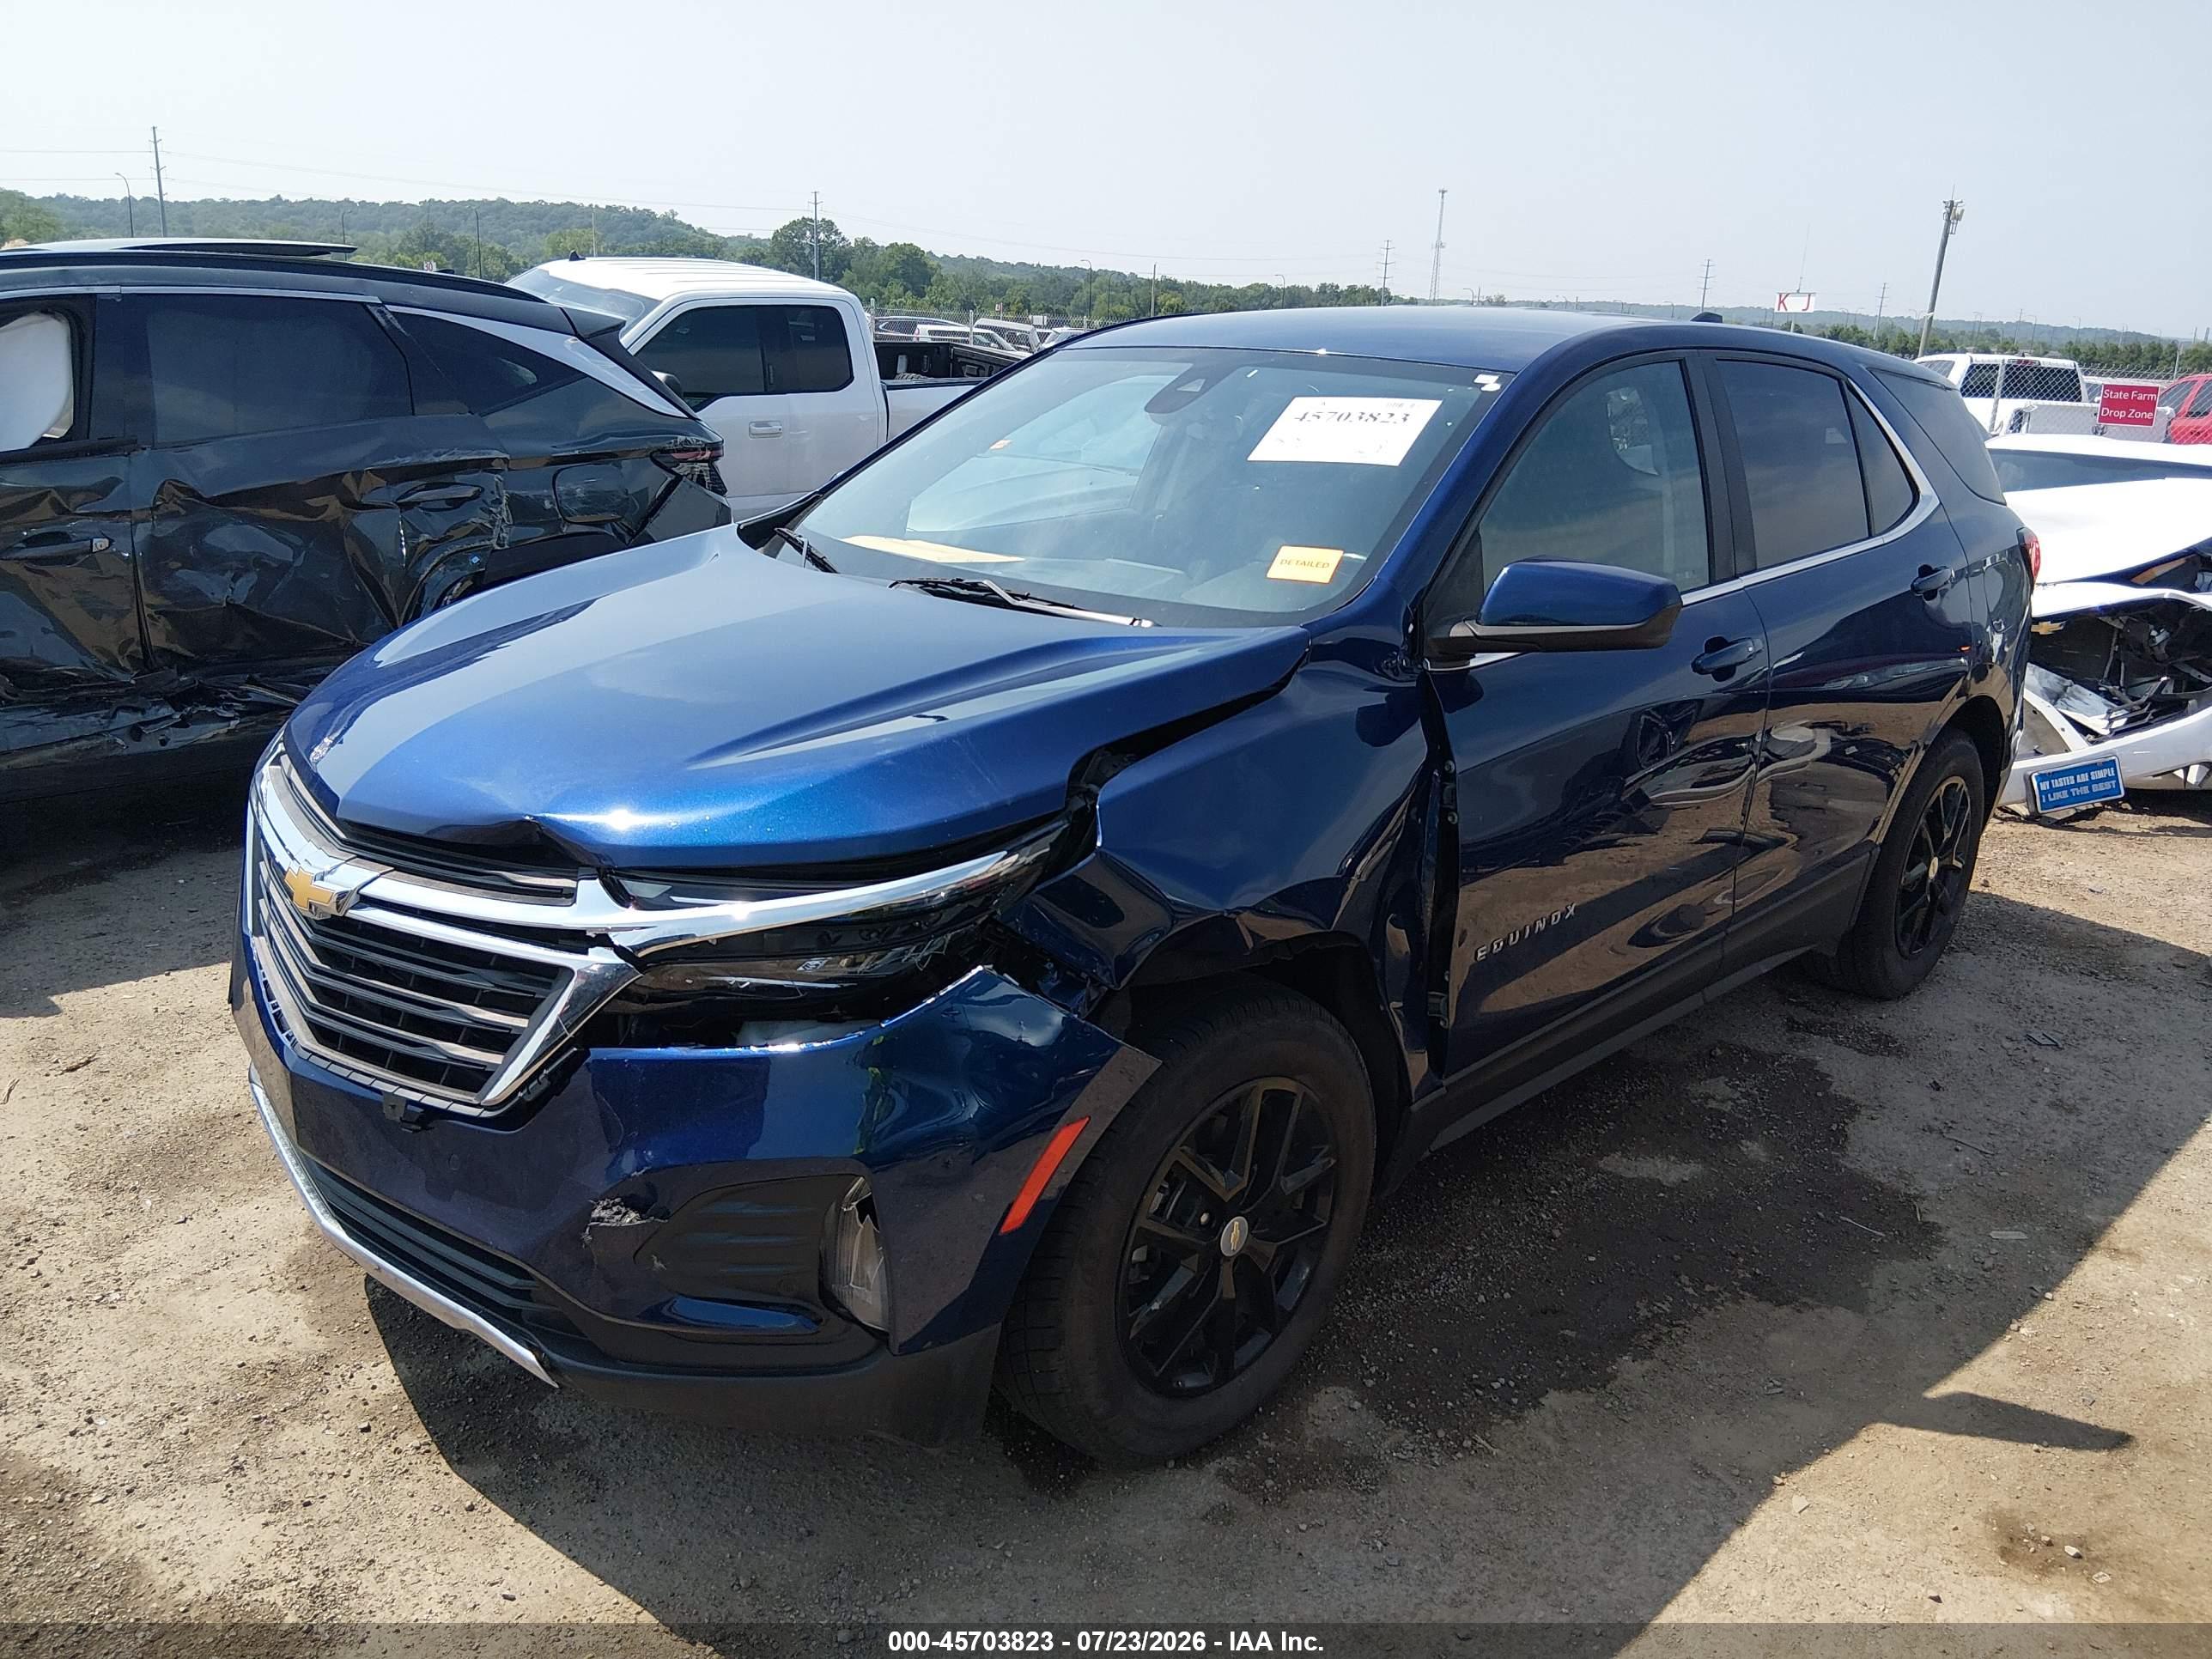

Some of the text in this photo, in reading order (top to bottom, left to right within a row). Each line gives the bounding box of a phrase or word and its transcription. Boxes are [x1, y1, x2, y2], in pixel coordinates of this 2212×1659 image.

[1778, 293, 1811, 312] K J
[2103, 389, 2156, 401] State Farm
[1294, 411, 1410, 424] 45703823
[2100, 407, 2154, 420] Drop Zone
[1280, 559, 1330, 568] DETAILED
[2076, 772, 2089, 783] ARE
[2091, 768, 2115, 780] SIMPLE
[2048, 790, 2069, 801] LIKE
[2070, 786, 2089, 796] THE
[2092, 781, 2116, 792] BEST
[1476, 902, 1577, 962] EQUINOX
